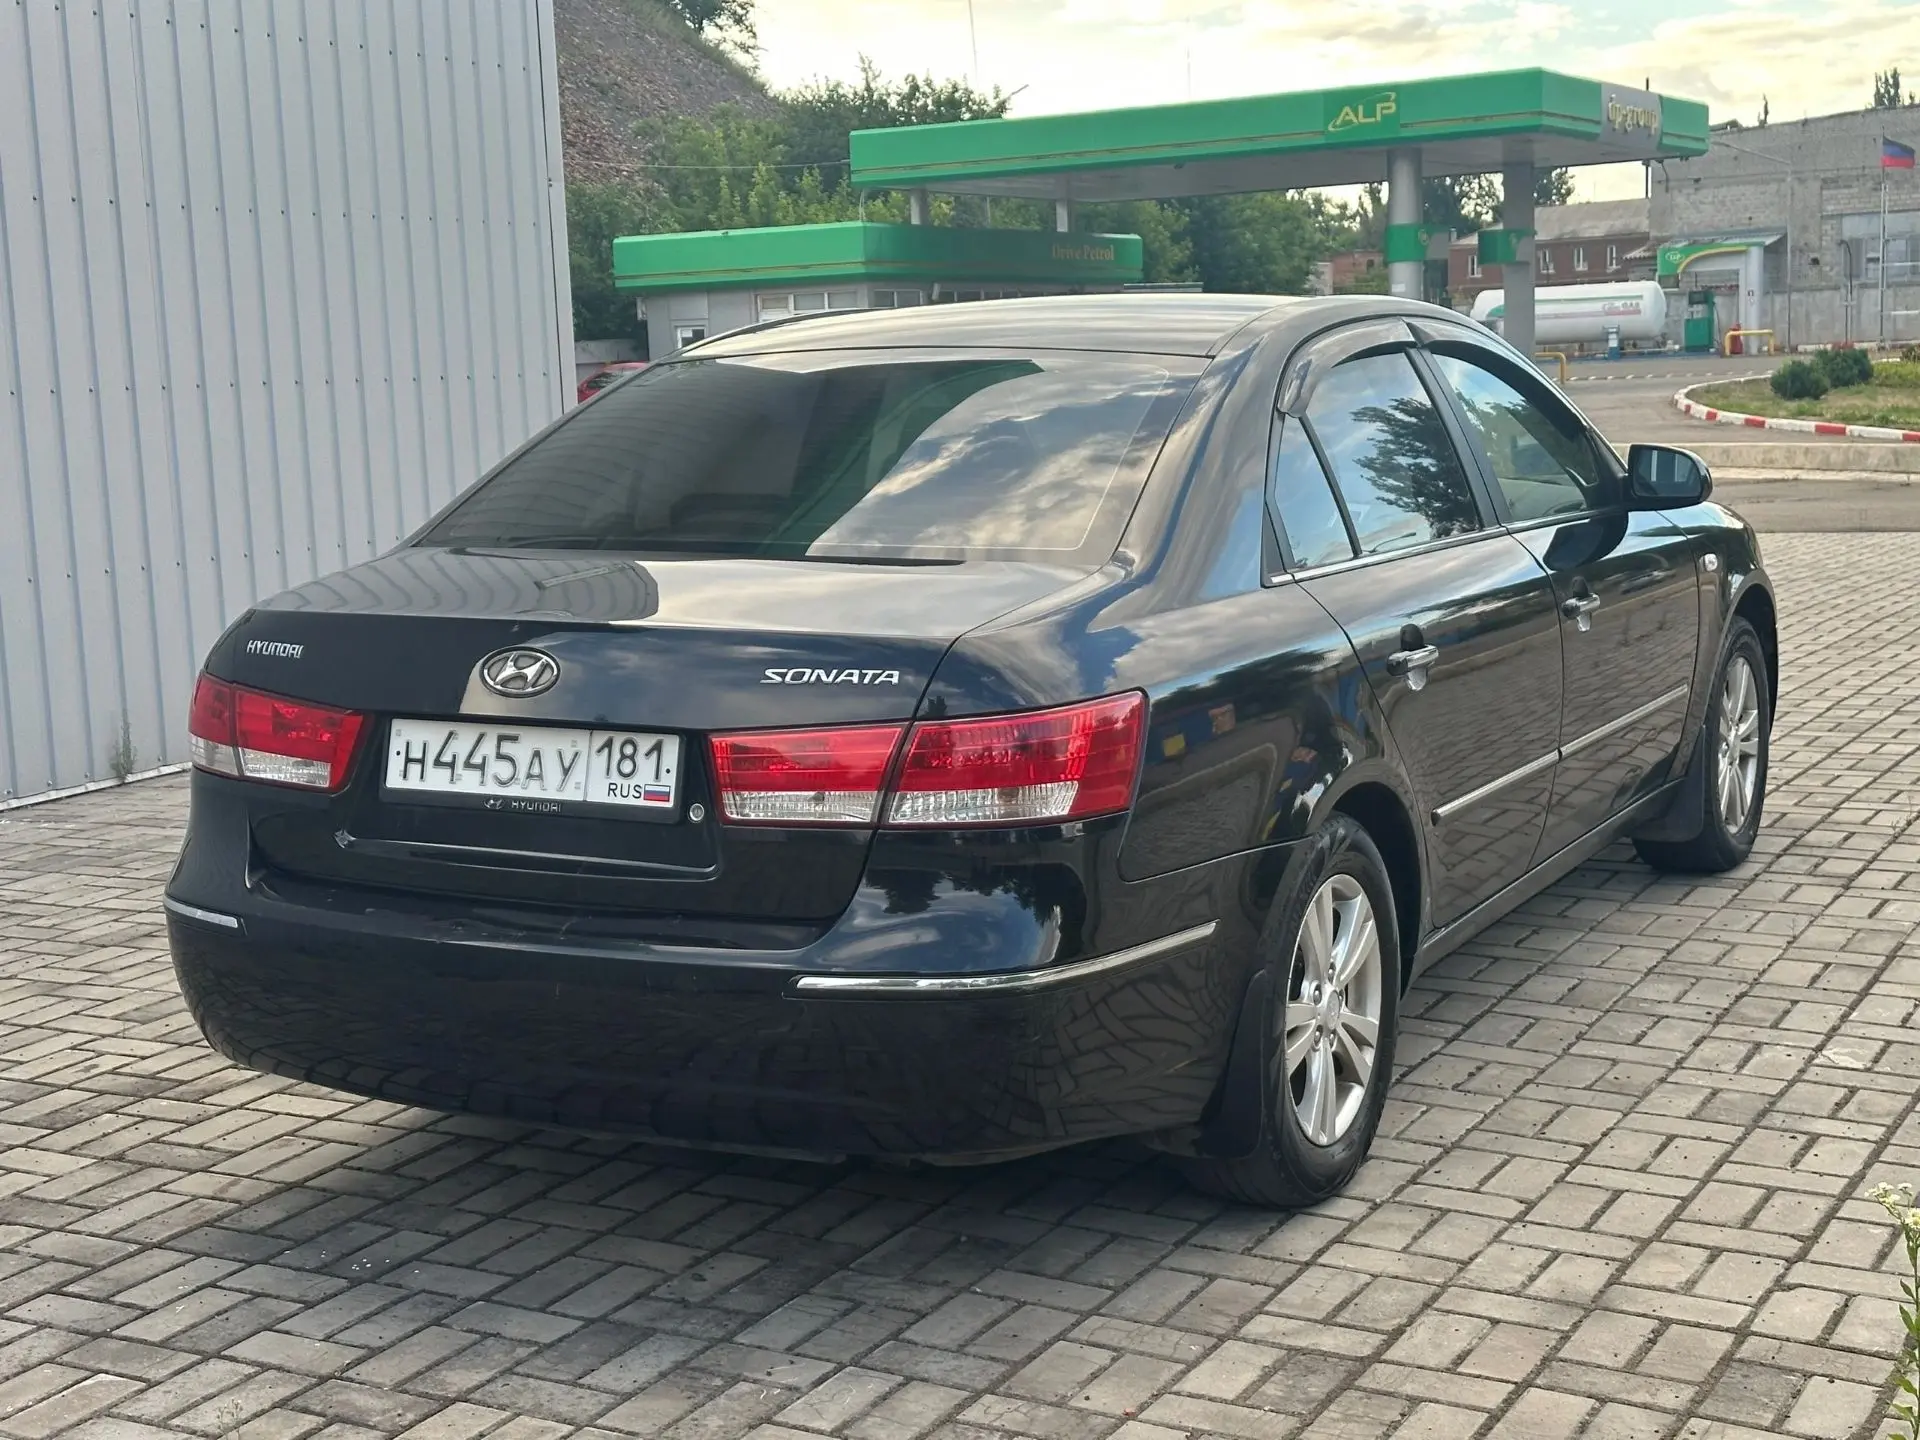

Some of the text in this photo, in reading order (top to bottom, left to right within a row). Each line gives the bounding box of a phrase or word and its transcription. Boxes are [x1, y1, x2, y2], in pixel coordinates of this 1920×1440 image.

[1334, 101, 1397, 125] ALP
[1052, 243, 1115, 261] Drive Petrol
[246, 639, 304, 659] HYUNDAI
[759, 667, 900, 685] SONATA
[595, 735, 666, 782] 181
[607, 783, 642, 799] RUS
[511, 800, 561, 813] HYUNDAI
